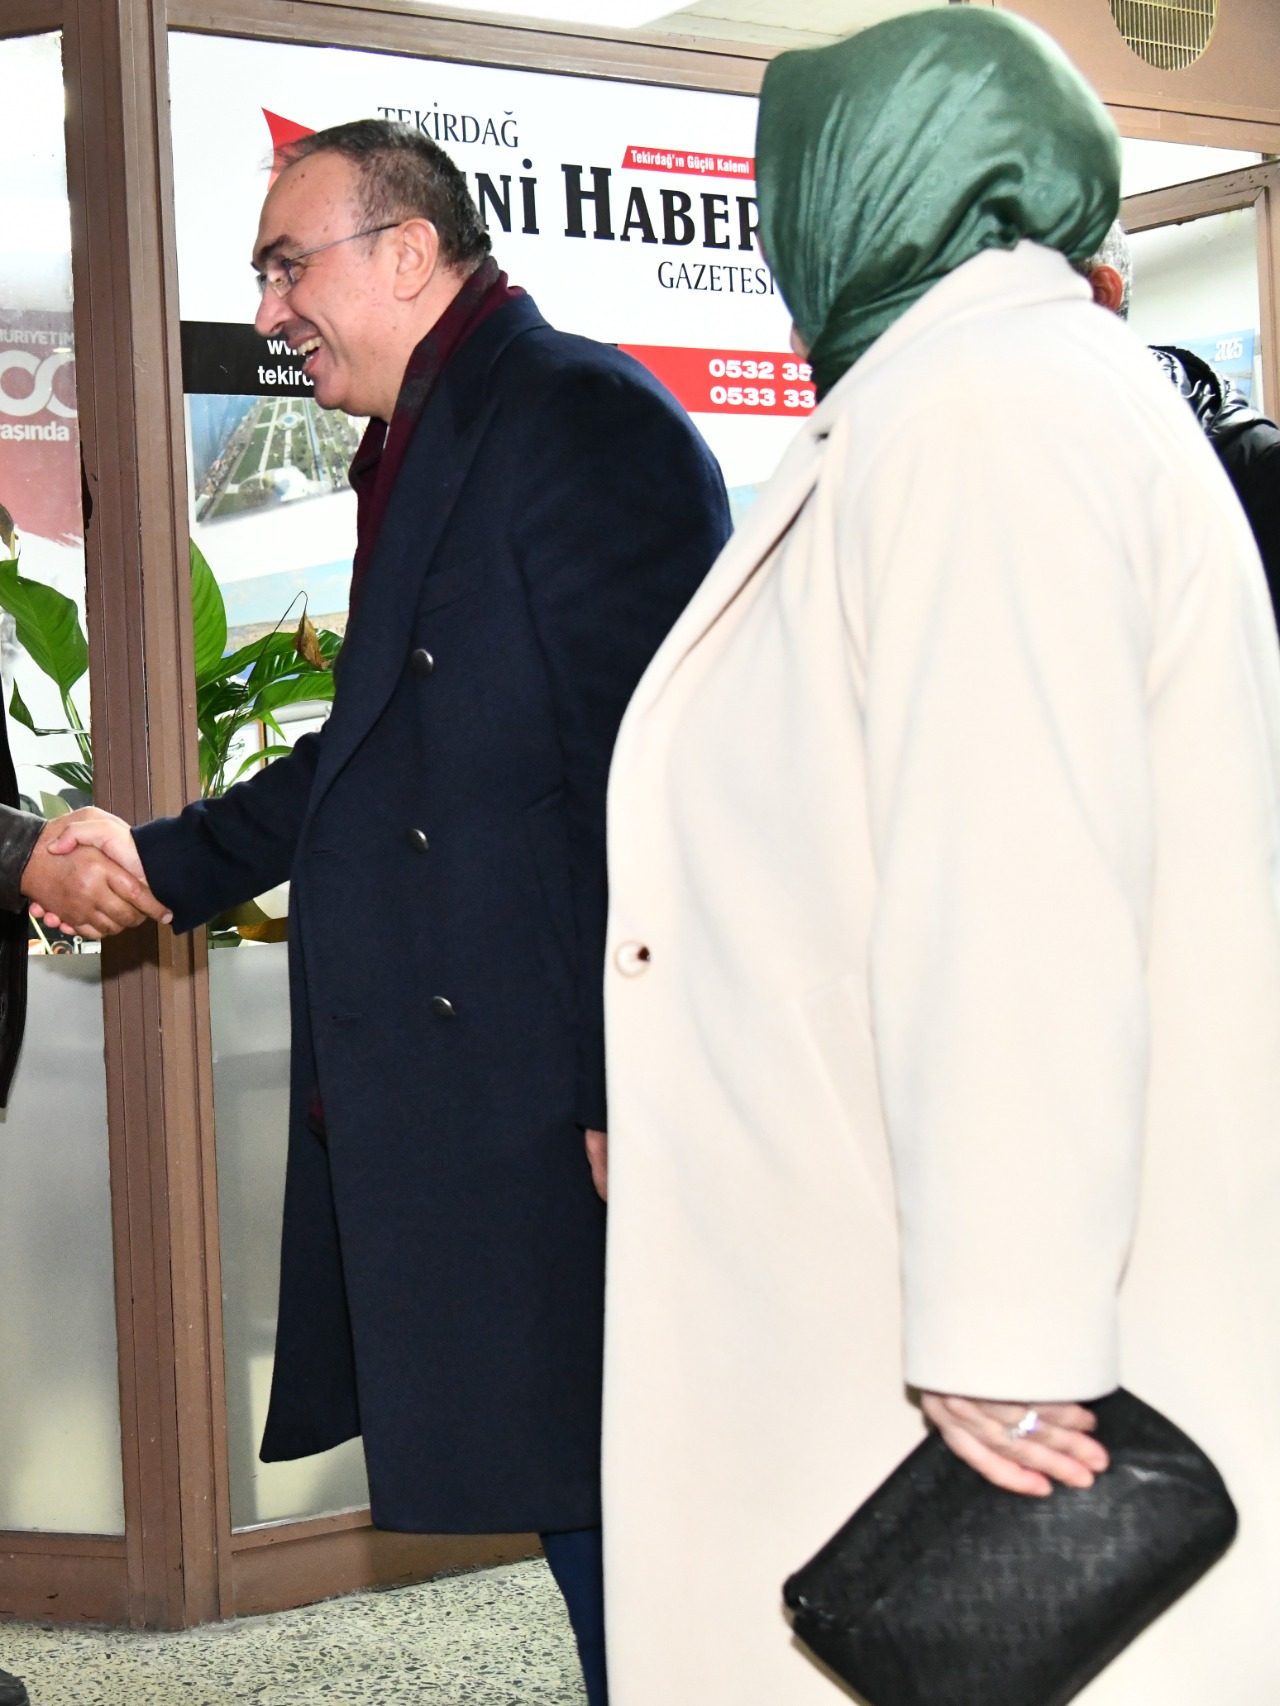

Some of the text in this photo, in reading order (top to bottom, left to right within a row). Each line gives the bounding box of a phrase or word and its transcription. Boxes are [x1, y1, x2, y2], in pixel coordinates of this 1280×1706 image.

[631, 150, 750, 174] Tekirdağ'ın Güçlü Kalemi
[463, 158, 540, 235] Nİ
[1215, 337, 1244, 361] 2025
[708, 358, 813, 382] 0532 35
[709, 385, 816, 408] 0533 33
